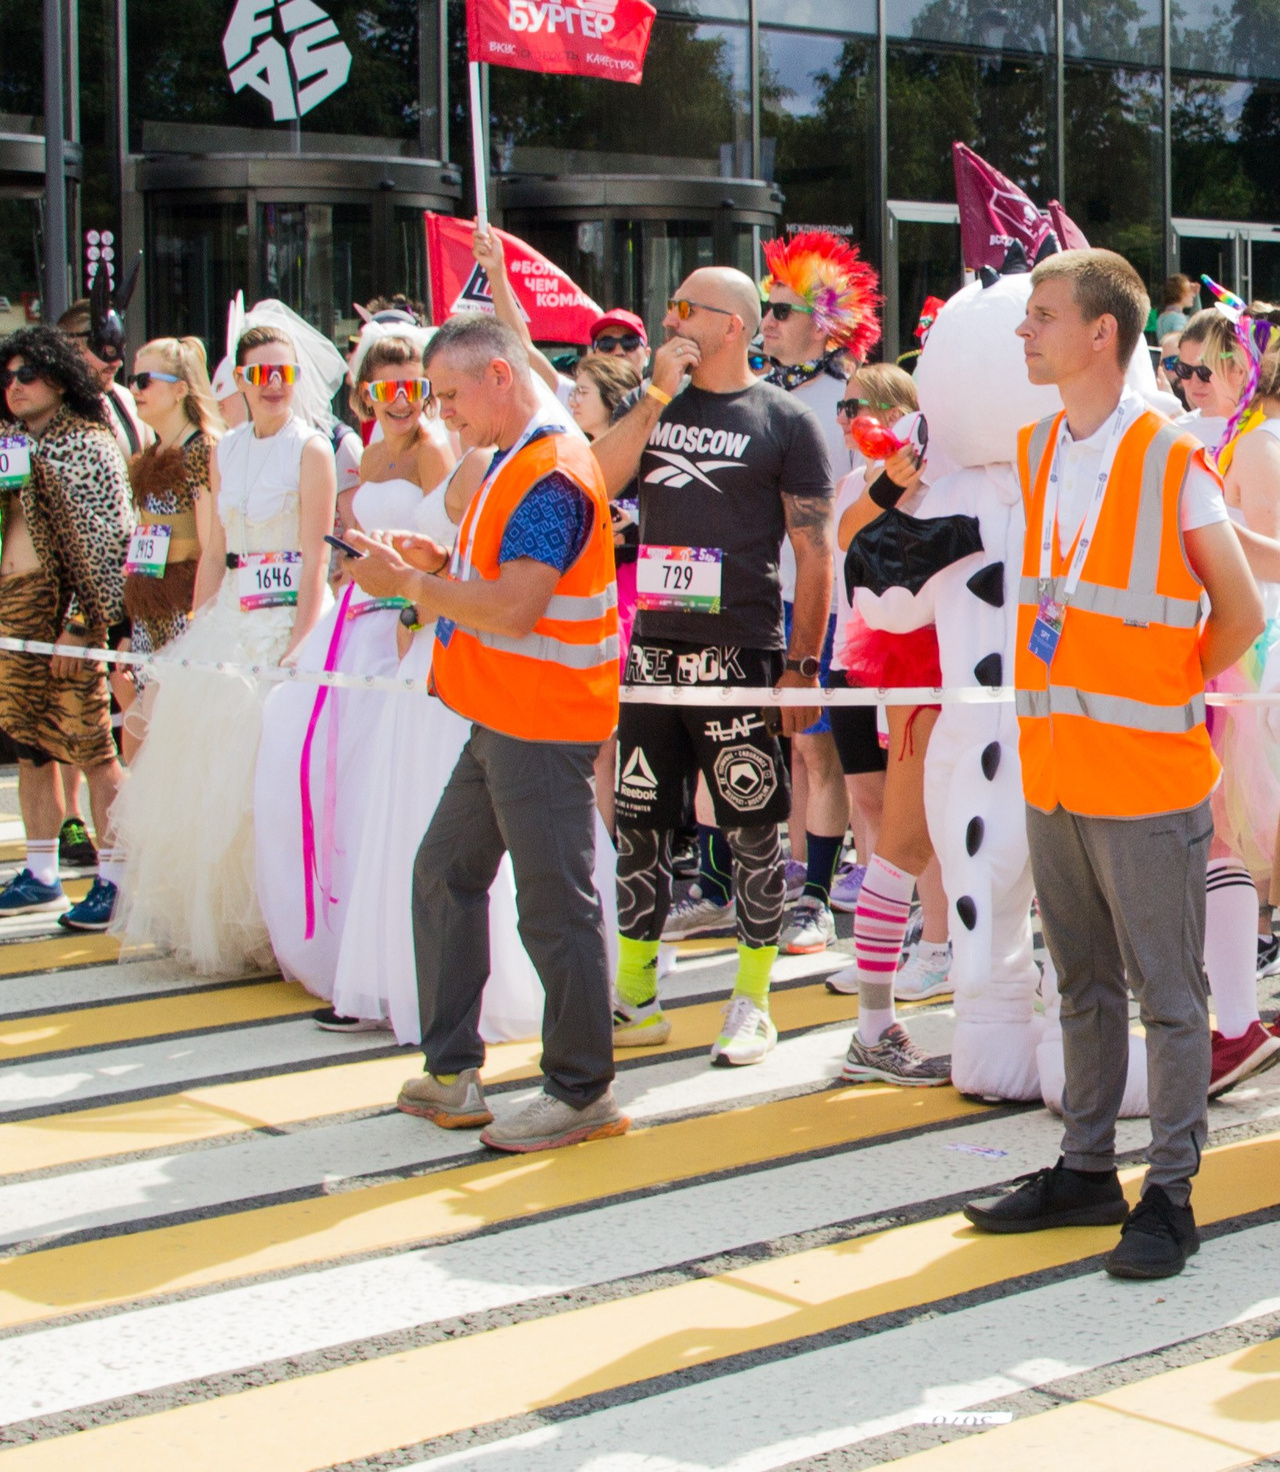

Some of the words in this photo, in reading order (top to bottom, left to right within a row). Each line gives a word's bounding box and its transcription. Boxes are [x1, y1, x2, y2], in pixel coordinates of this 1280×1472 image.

[508, 2, 615, 39] БУРГЕР
[524, 278, 559, 293] ЧЕМ
[648, 421, 752, 459] MOSCOW
[256, 567, 292, 589] 1646
[662, 565, 693, 590] 729
[621, 784, 657, 800] Reebok
